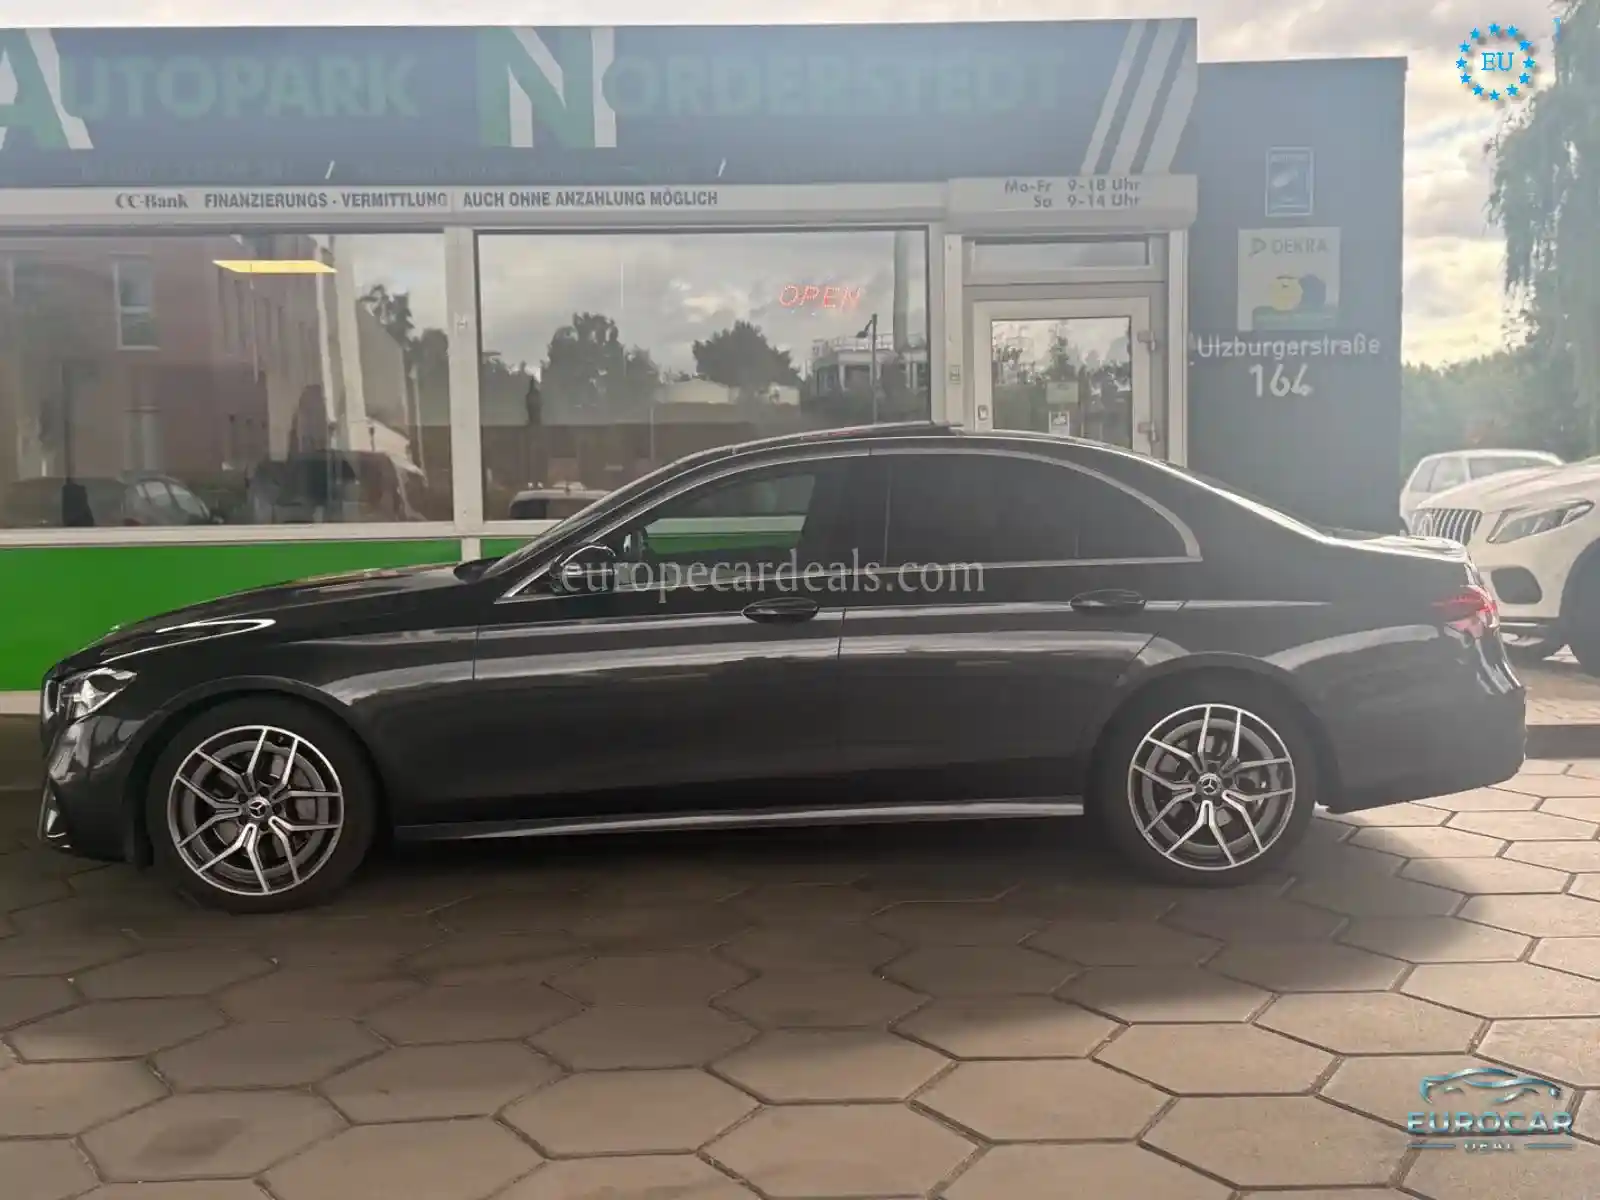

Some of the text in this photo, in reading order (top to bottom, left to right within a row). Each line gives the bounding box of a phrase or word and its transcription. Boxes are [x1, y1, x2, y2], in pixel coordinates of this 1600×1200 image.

[1112, 177, 1140, 192] Uhr
[204, 192, 328, 209] FINANZIERUNGS
[341, 192, 448, 208] VERMITTLUNG
[463, 189, 718, 207] AUCH OHNE ANZAHLUNG MÖGLICH
[1111, 193, 1140, 208] Uhr
[1271, 237, 1329, 255] DEKRA
[779, 284, 861, 309] OPEN
[1197, 332, 1381, 360] Ulzburgerstraße
[1249, 363, 1313, 397] 164
